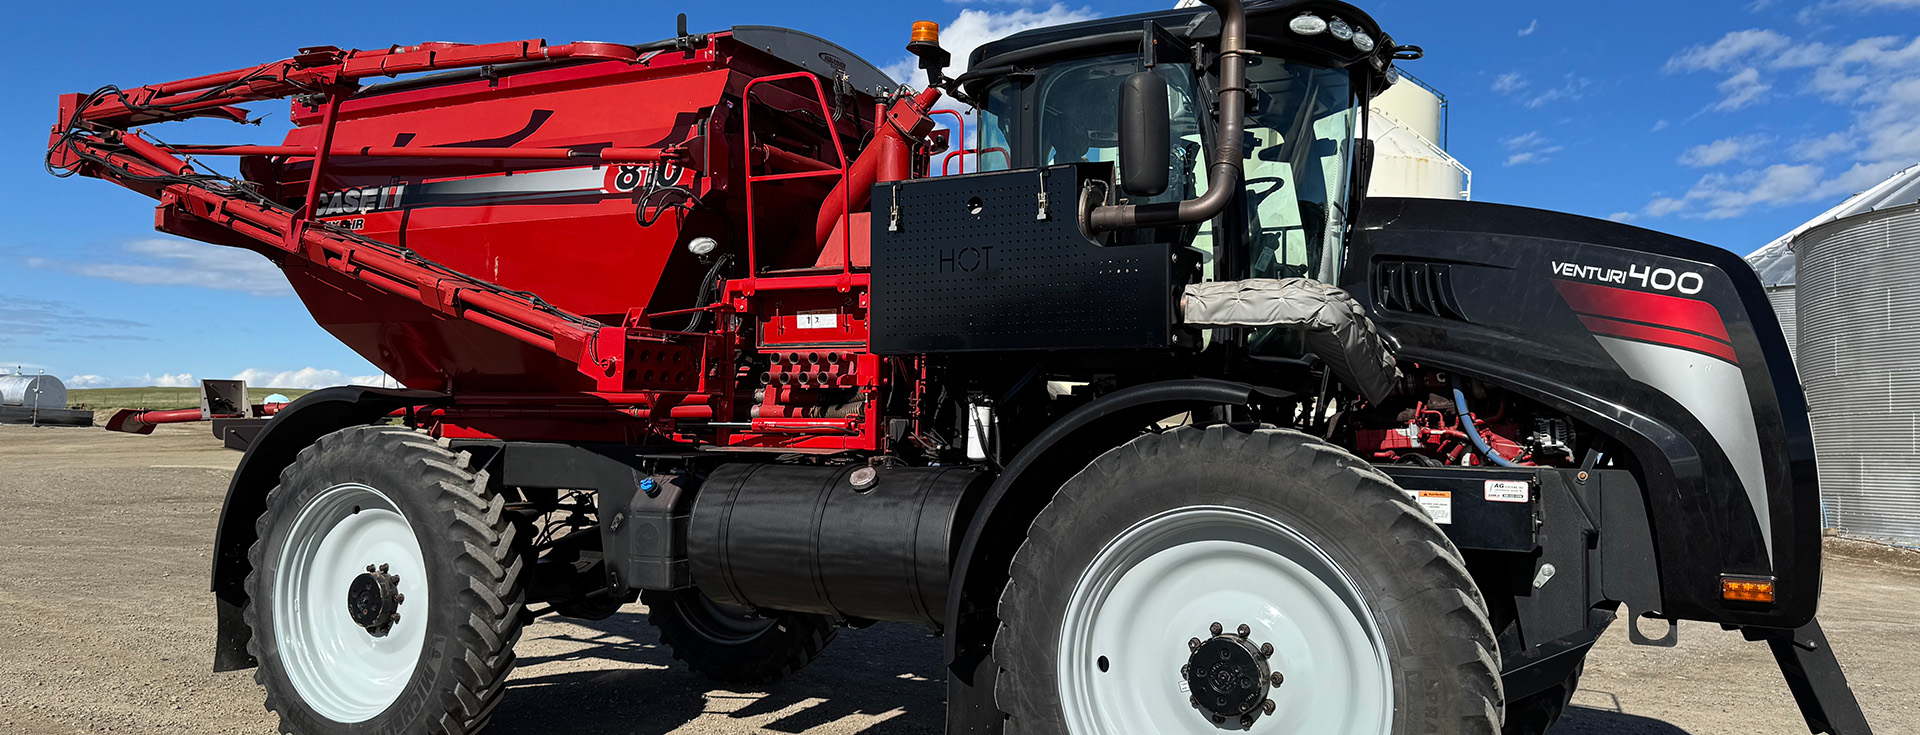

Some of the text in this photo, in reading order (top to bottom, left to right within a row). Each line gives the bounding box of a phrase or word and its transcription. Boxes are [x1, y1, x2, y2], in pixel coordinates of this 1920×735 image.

[316, 187, 379, 216] CASE
[940, 245, 993, 273] HOT
[1551, 261, 1704, 295] VENTURI 400
